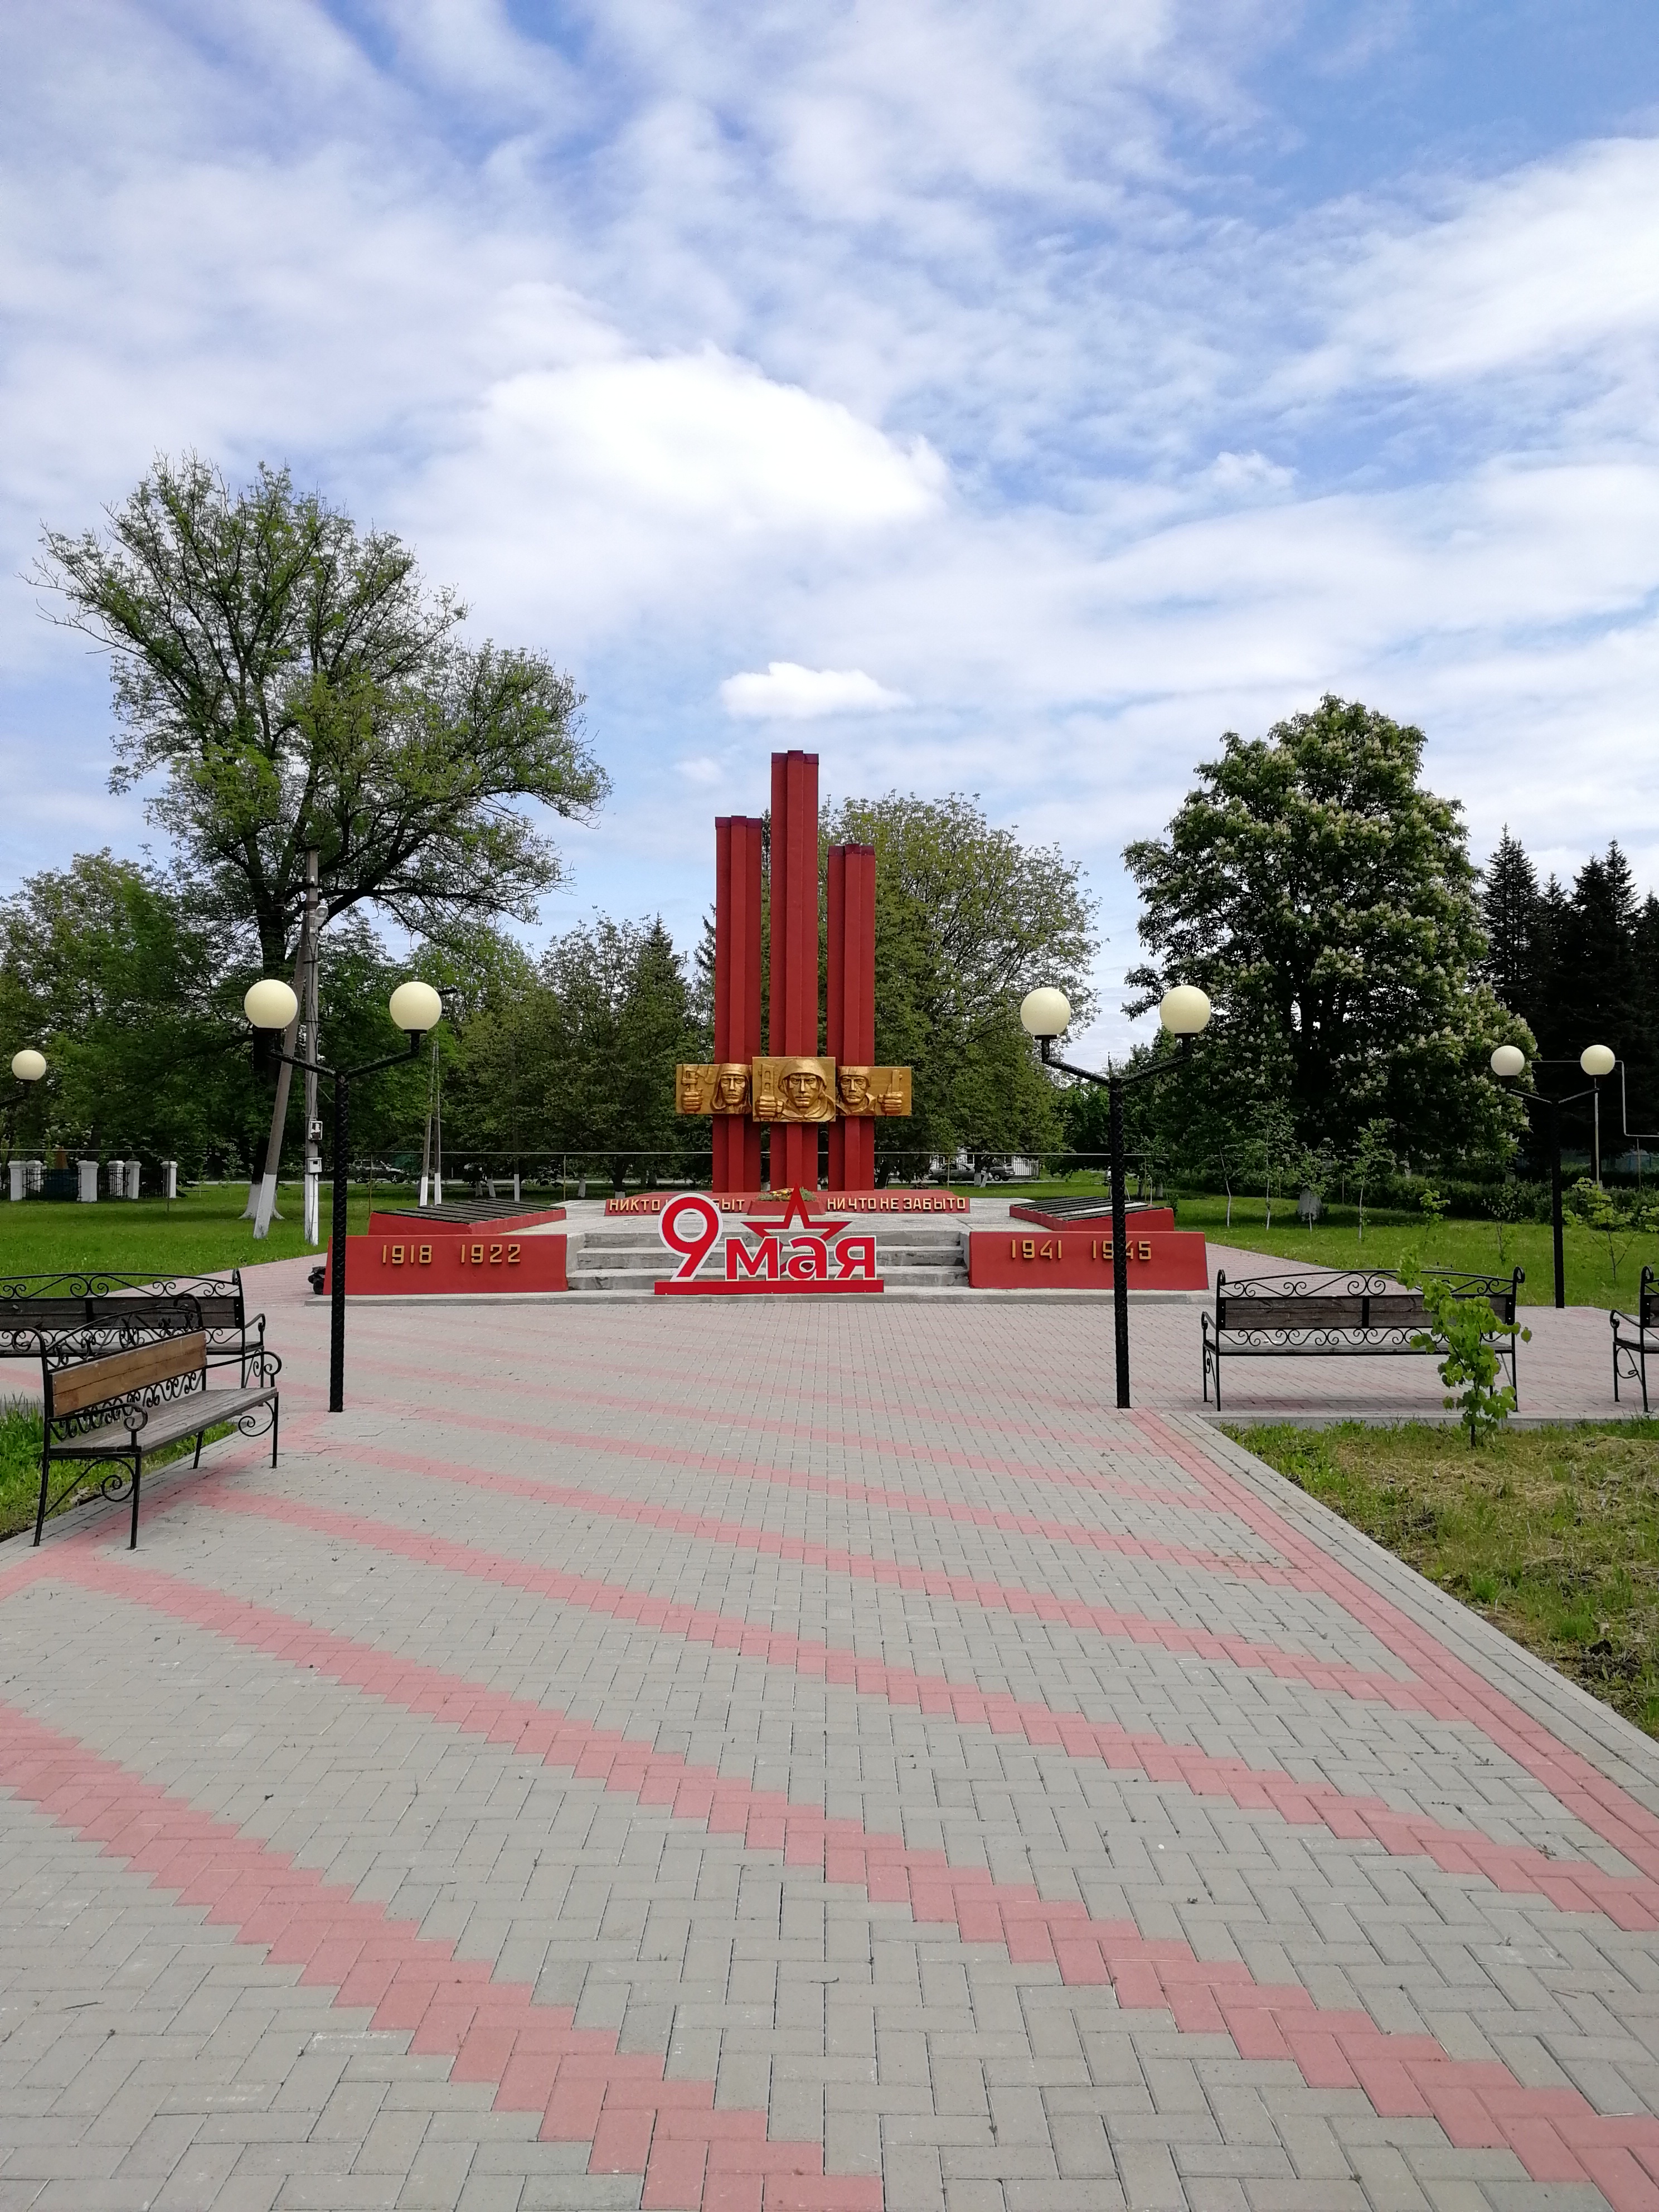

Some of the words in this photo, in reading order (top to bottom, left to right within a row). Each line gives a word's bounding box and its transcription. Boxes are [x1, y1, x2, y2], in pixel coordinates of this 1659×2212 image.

[609, 1199, 660, 1211] НИКТО
[880, 1197, 899, 1210] НЕ
[903, 1197, 966, 1210] ЗАБЫТО
[658, 1192, 724, 1282] 9
[382, 1244, 432, 1264] 1918
[461, 1244, 521, 1263] 1922
[1012, 1239, 1062, 1259] 1941
